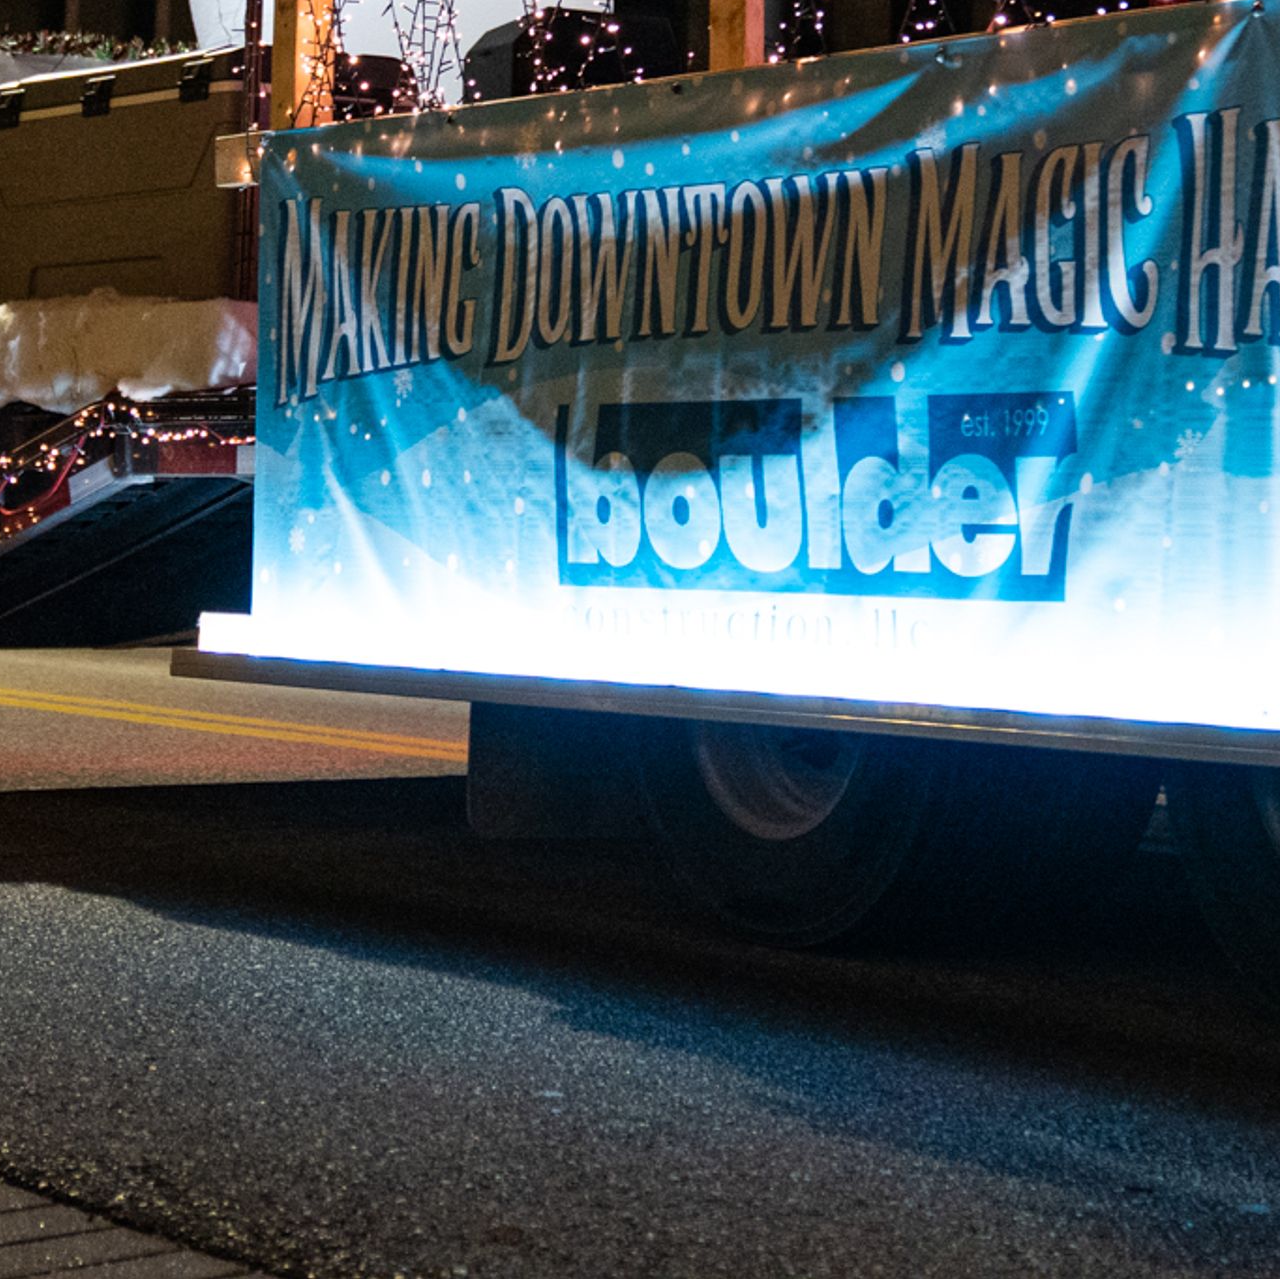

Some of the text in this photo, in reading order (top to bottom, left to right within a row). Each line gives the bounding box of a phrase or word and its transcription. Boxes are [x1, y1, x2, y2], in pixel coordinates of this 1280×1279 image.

[275, 195, 481, 408] MAKING
[485, 166, 890, 368] DOWNTOWN
[896, 133, 1160, 344] MAGIC
[566, 396, 1079, 578] boulder
[960, 407, 1050, 438] est. 1999
